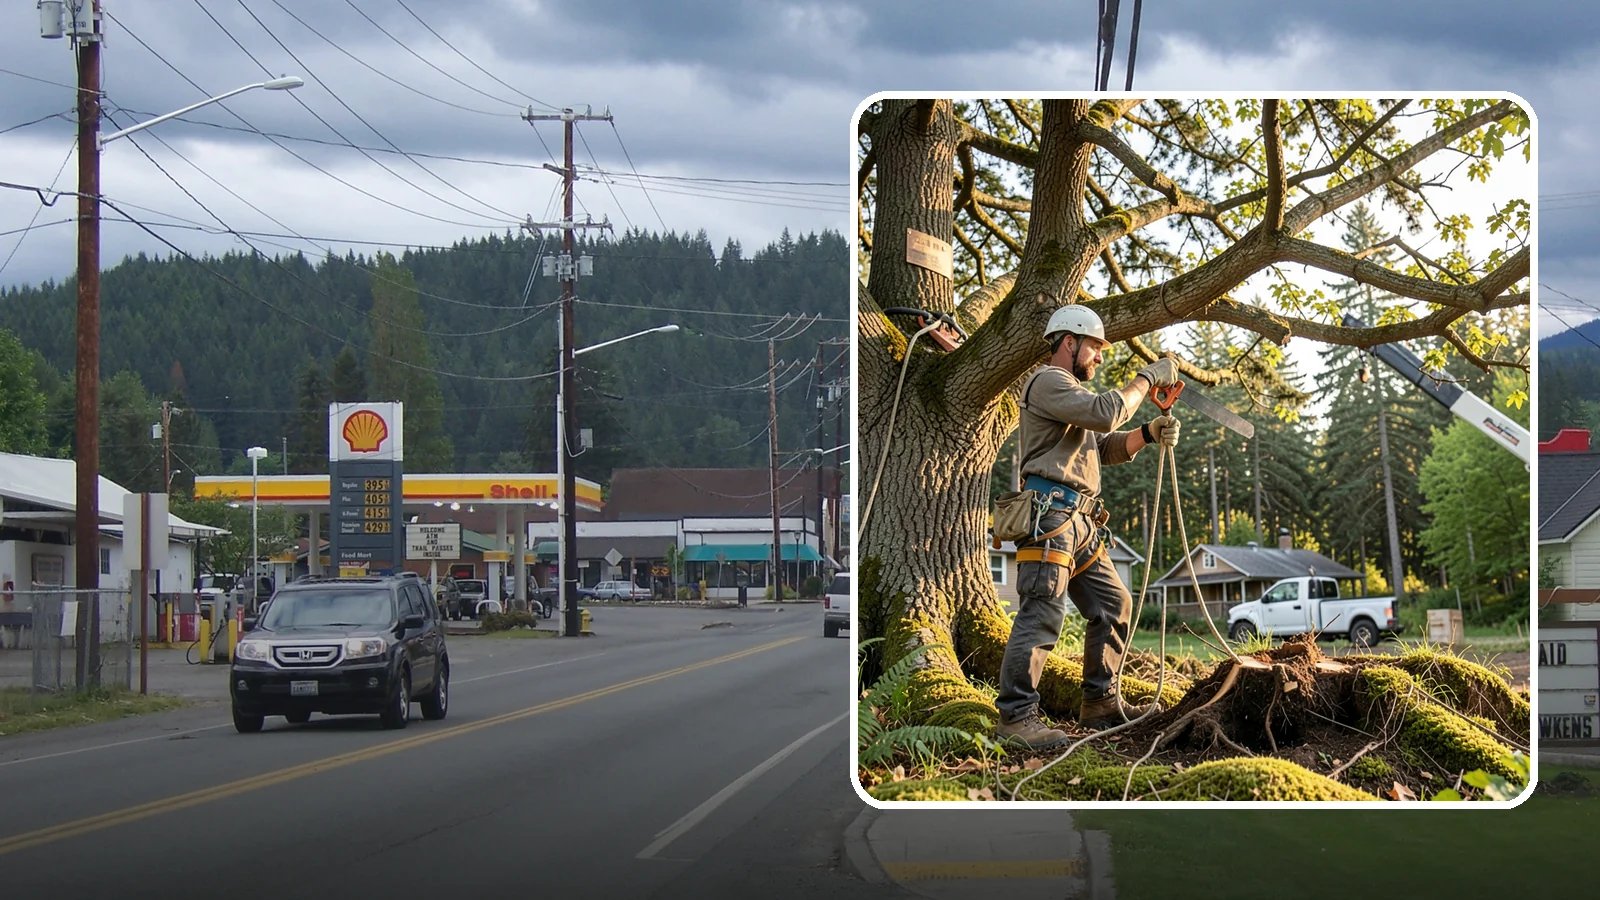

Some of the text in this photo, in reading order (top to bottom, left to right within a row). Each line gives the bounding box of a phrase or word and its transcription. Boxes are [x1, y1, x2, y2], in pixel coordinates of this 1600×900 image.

[365, 480, 384, 490] 395
[490, 484, 547, 499] Shell
[365, 494, 384, 504] 405
[365, 508, 384, 518] 415
[366, 522, 384, 532] 429
